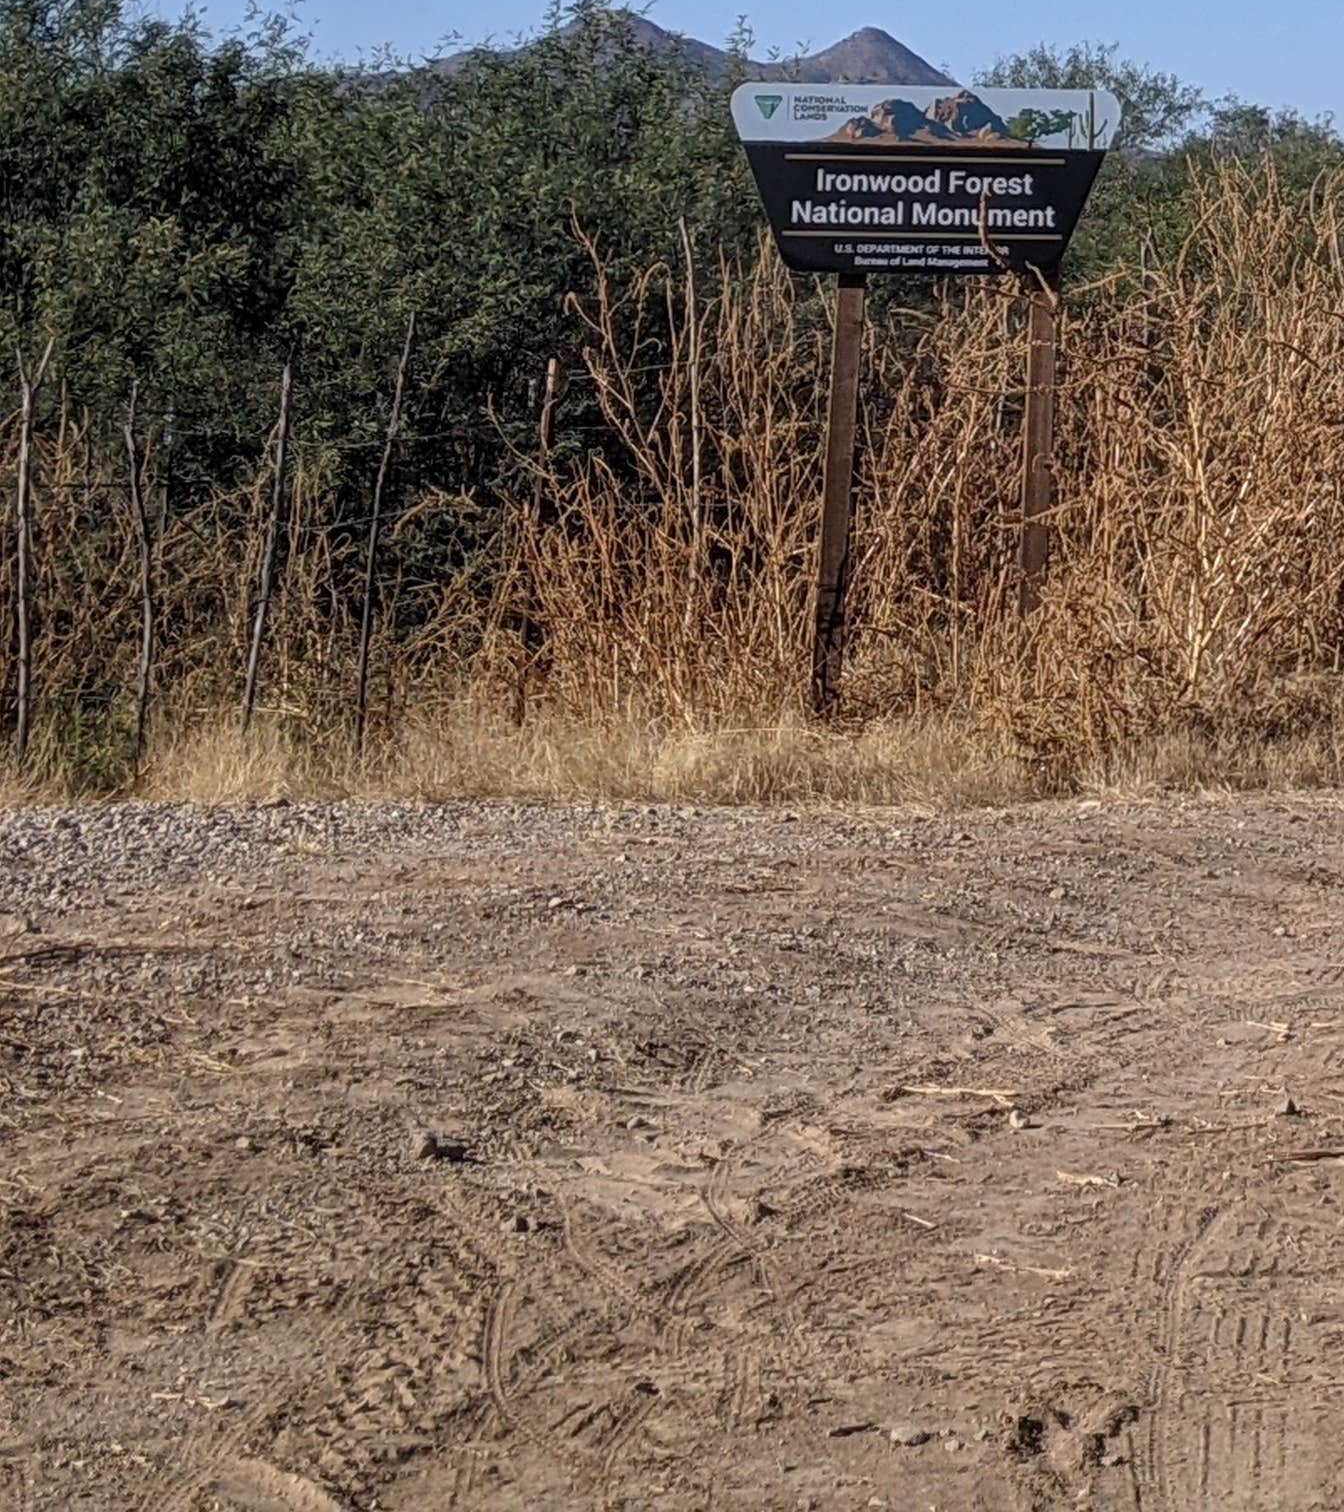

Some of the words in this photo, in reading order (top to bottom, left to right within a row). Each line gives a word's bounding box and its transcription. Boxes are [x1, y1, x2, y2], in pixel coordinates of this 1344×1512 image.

[794, 95, 847, 104] NATIONAL
[794, 104, 868, 112] CONSERVATION
[794, 112, 827, 120] LANDS
[816, 168, 941, 192] Ironwood
[948, 170, 1033, 194] Forest
[791, 199, 904, 223] National
[911, 201, 1056, 227] Monument
[834, 244, 853, 253] U.S.
[856, 244, 924, 254] DEPARTMENT
[926, 245, 938, 254] OF
[942, 245, 961, 255] THE
[854, 256, 888, 265] Bureau
[889, 256, 900, 265] of
[902, 256, 925, 265] Land
[927, 257, 989, 268] Management
